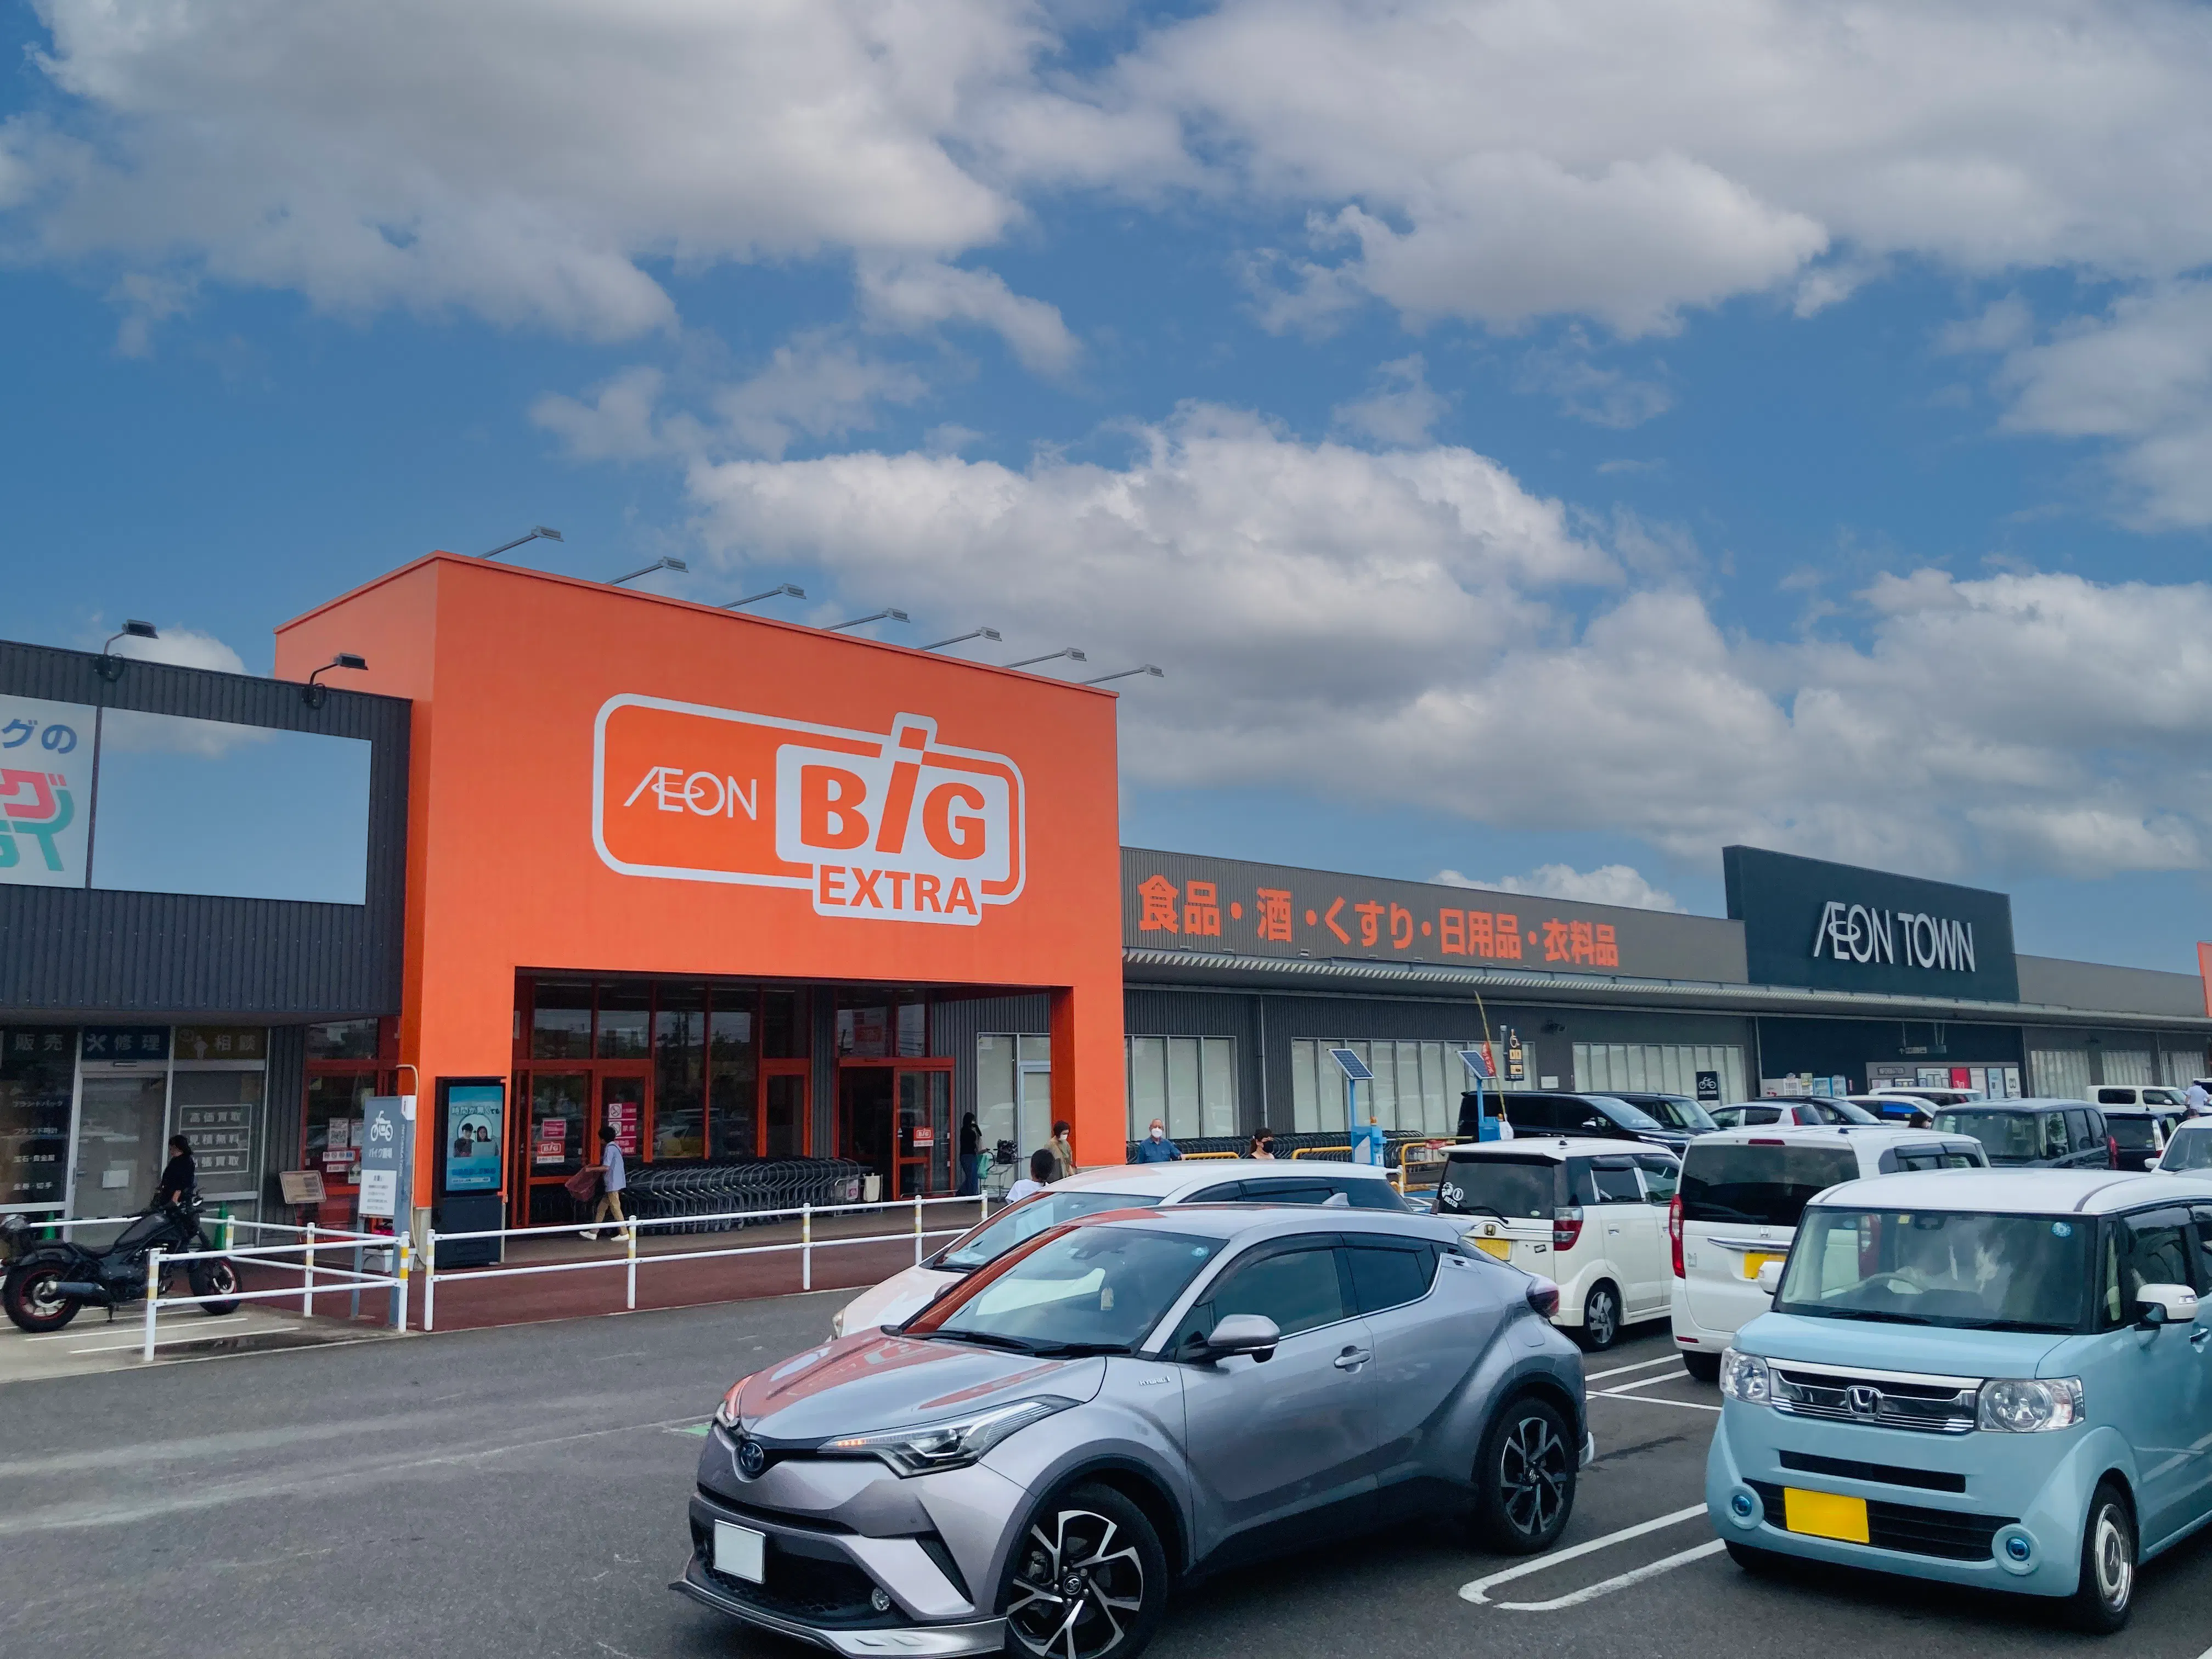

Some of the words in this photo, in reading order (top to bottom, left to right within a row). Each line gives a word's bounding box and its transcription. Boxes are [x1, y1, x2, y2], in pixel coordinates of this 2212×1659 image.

[800, 726, 986, 860] BIG
[819, 866, 978, 916] EXTRA
[1897, 912, 1976, 973] TOWN
